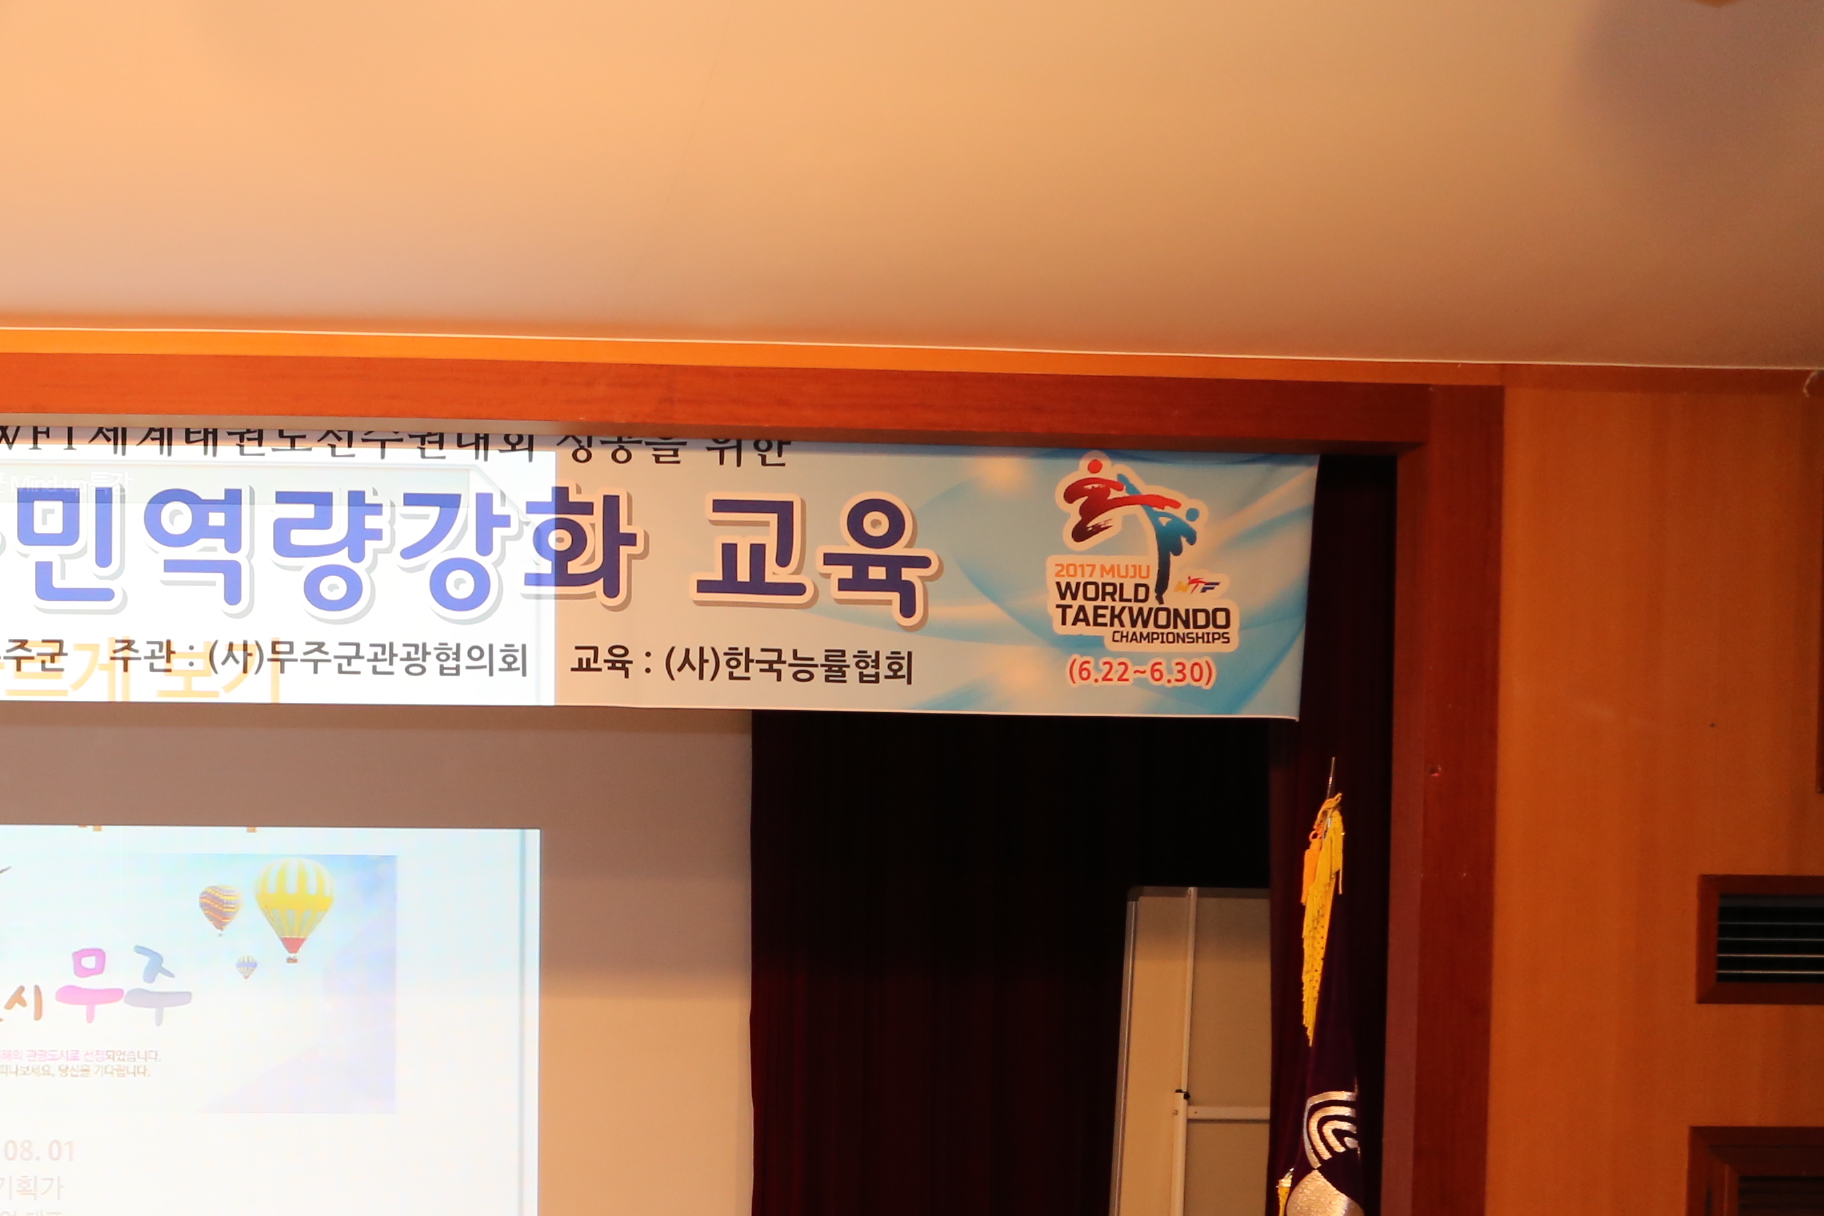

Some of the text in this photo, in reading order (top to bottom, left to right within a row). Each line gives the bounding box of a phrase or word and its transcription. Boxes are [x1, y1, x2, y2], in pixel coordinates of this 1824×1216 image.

[696, 497, 933, 619] 교육
[1054, 564, 1150, 579] 2017 MUJU
[1056, 581, 1150, 603] WORLD
[1055, 603, 1231, 630] TAEKWONDO
[1112, 630, 1230, 644] CHAMPIONSHIPS
[110, 638, 174, 674] 주관
[209, 638, 528, 679] (사)무주군관광협의회
[570, 644, 634, 677] 교육
[665, 645, 915, 686] (사)한국능률협회
[1069, 658, 1213, 686] (6.22~6.30)
[55, 945, 193, 1026] 무주
[47, 1139, 75, 1162] 01
